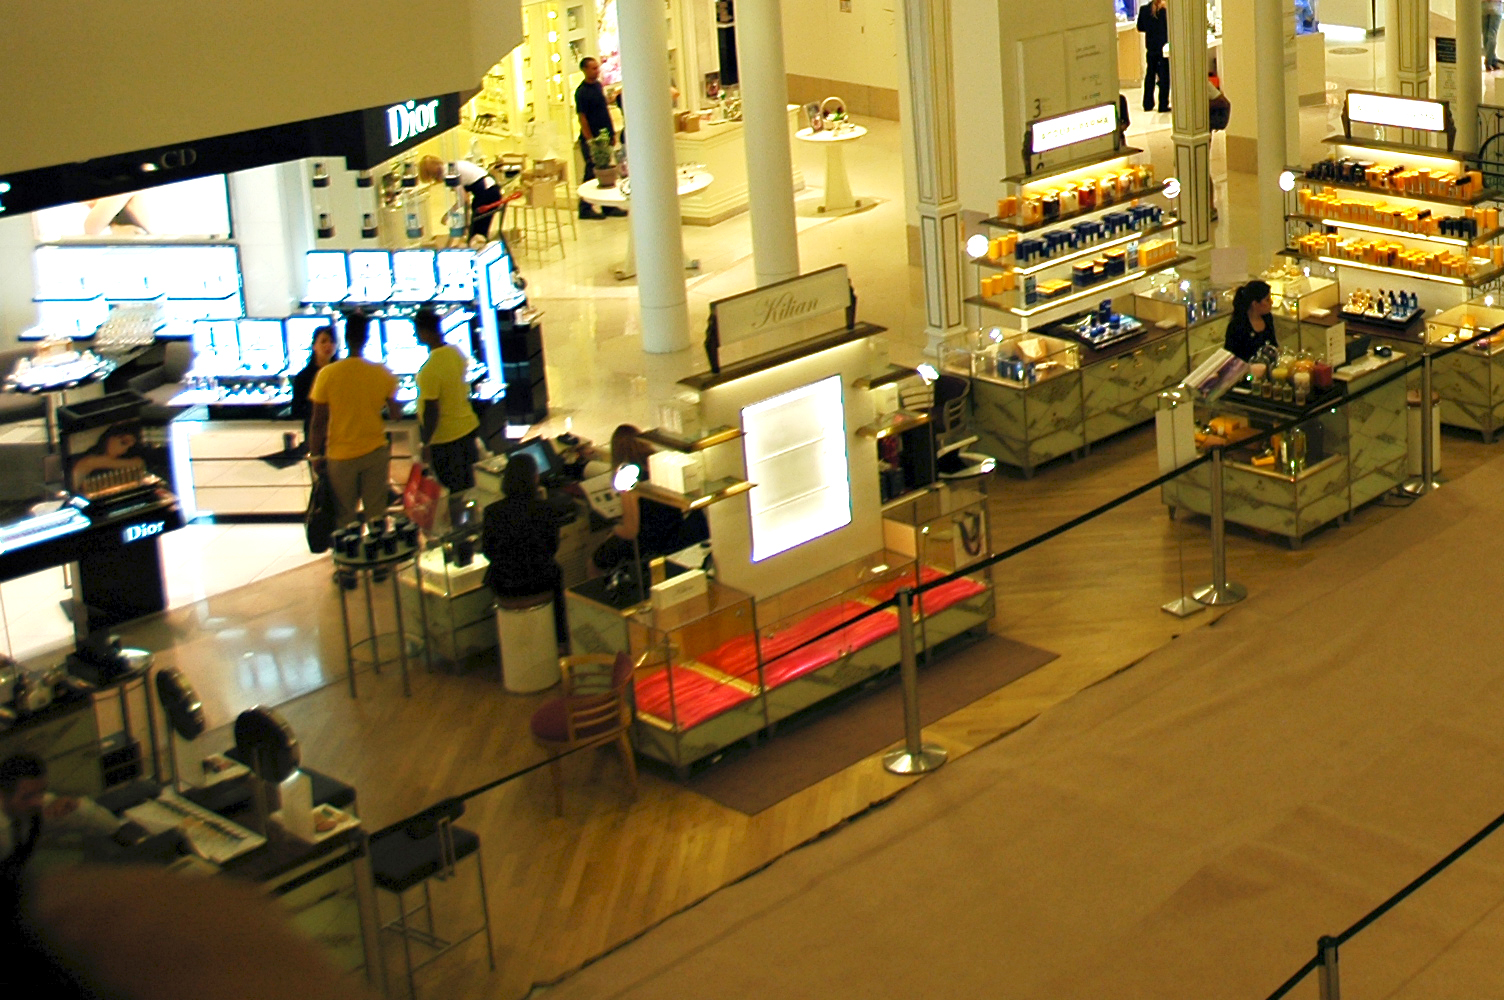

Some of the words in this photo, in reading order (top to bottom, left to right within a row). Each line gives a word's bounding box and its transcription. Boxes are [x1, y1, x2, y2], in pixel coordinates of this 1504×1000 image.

[385, 99, 439, 147] Dior
[160, 148, 197, 169] CD
[751, 292, 819, 329] Kilian
[123, 520, 165, 543] Dior
